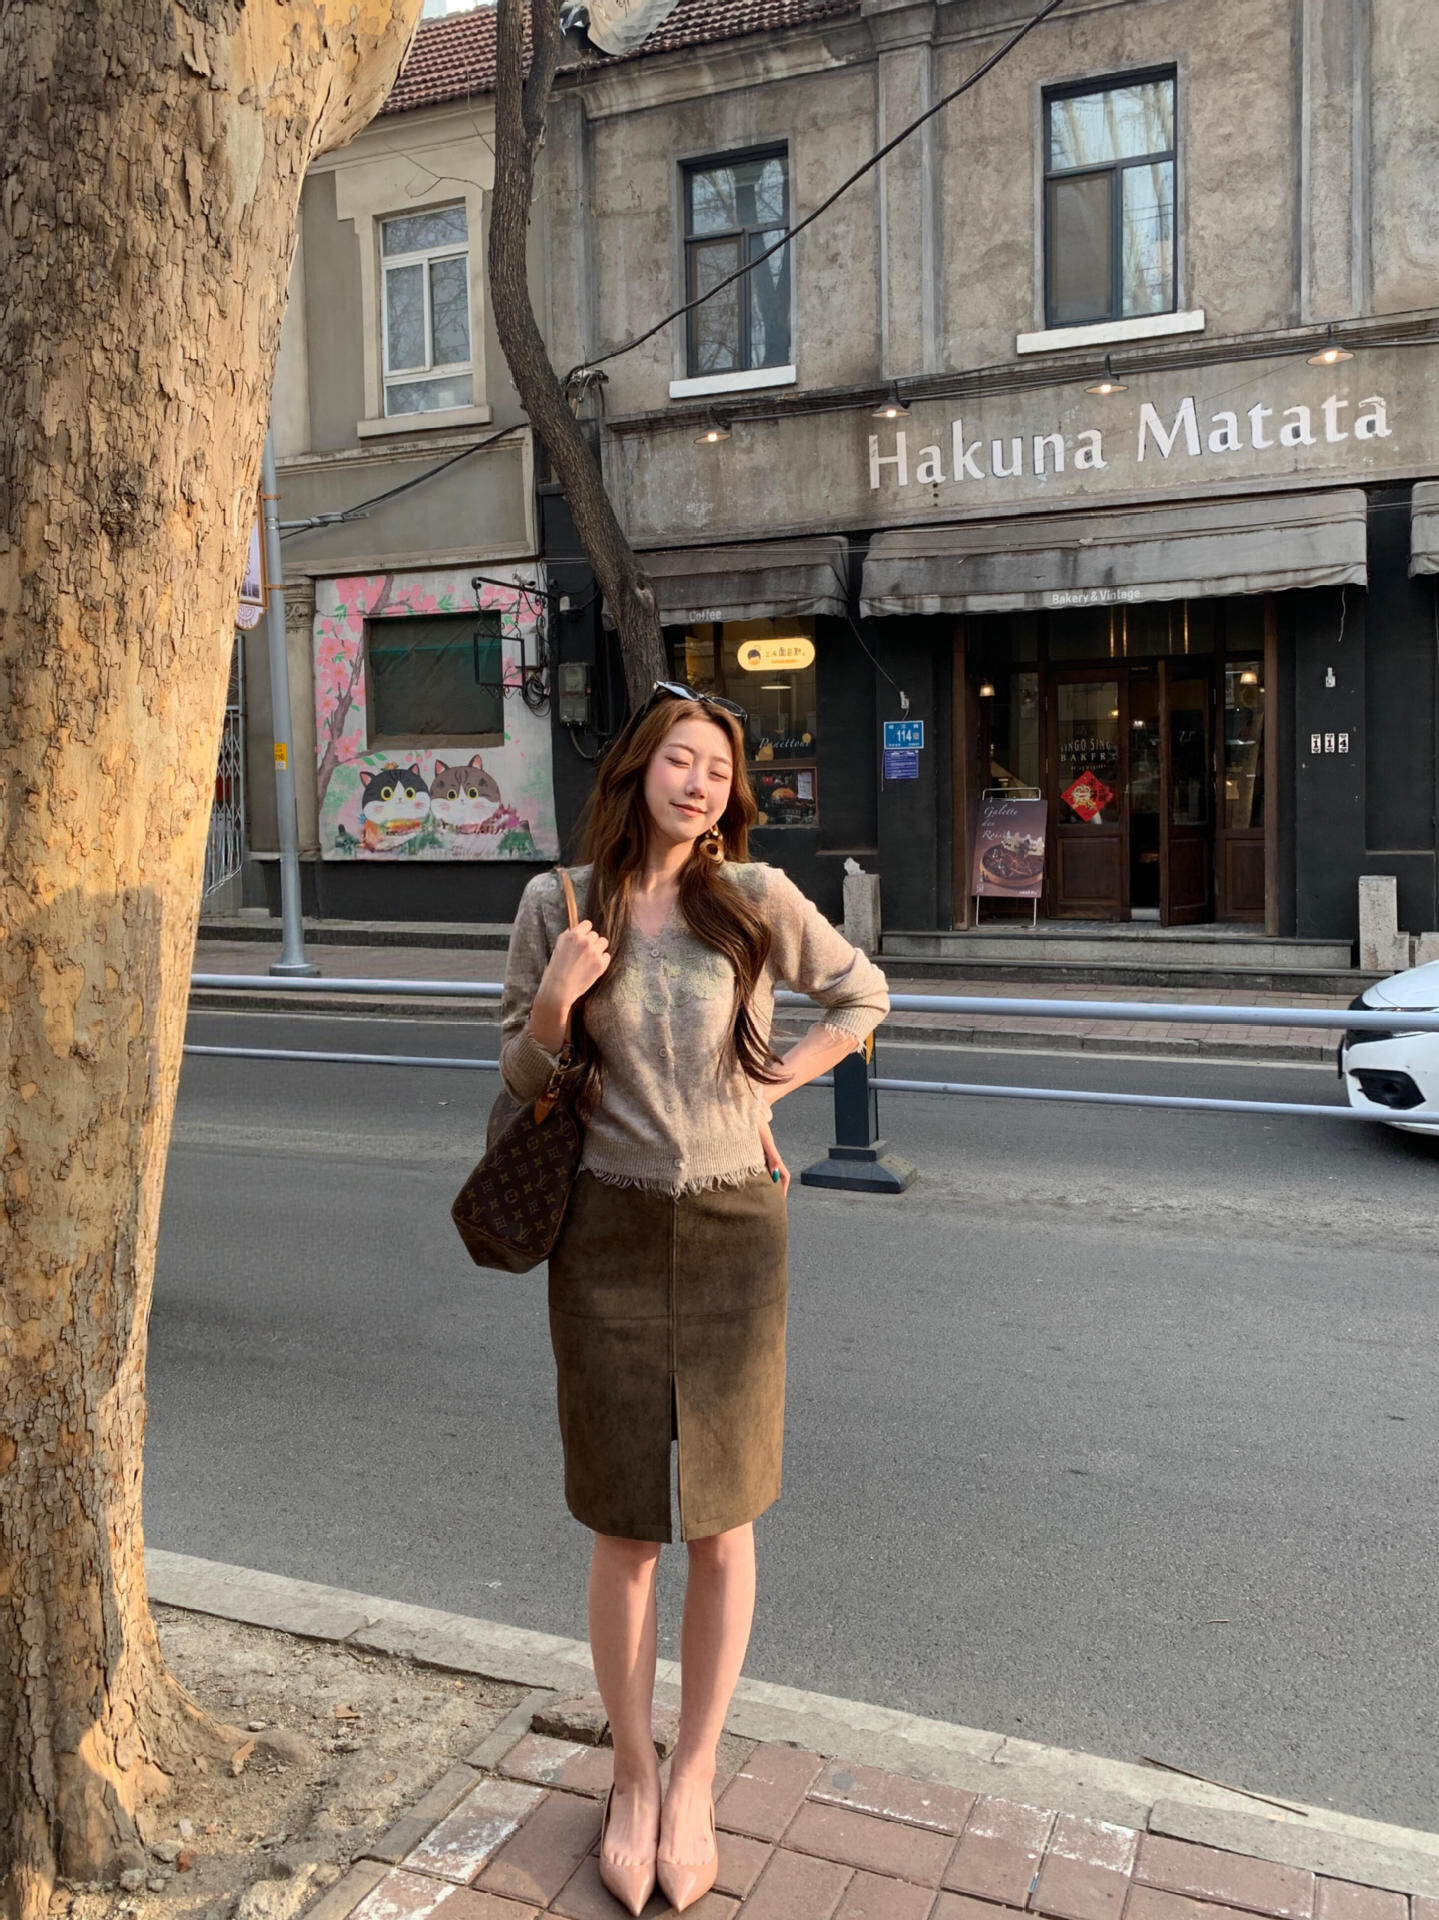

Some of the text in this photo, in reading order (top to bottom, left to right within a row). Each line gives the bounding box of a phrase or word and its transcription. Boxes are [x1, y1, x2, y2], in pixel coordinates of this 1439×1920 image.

[868, 394, 1393, 490] Hakuna Matata
[1052, 589, 1141, 605] Bakery & Vintage
[688, 608, 722, 623] Coffee
[896, 729, 912, 742] 114
